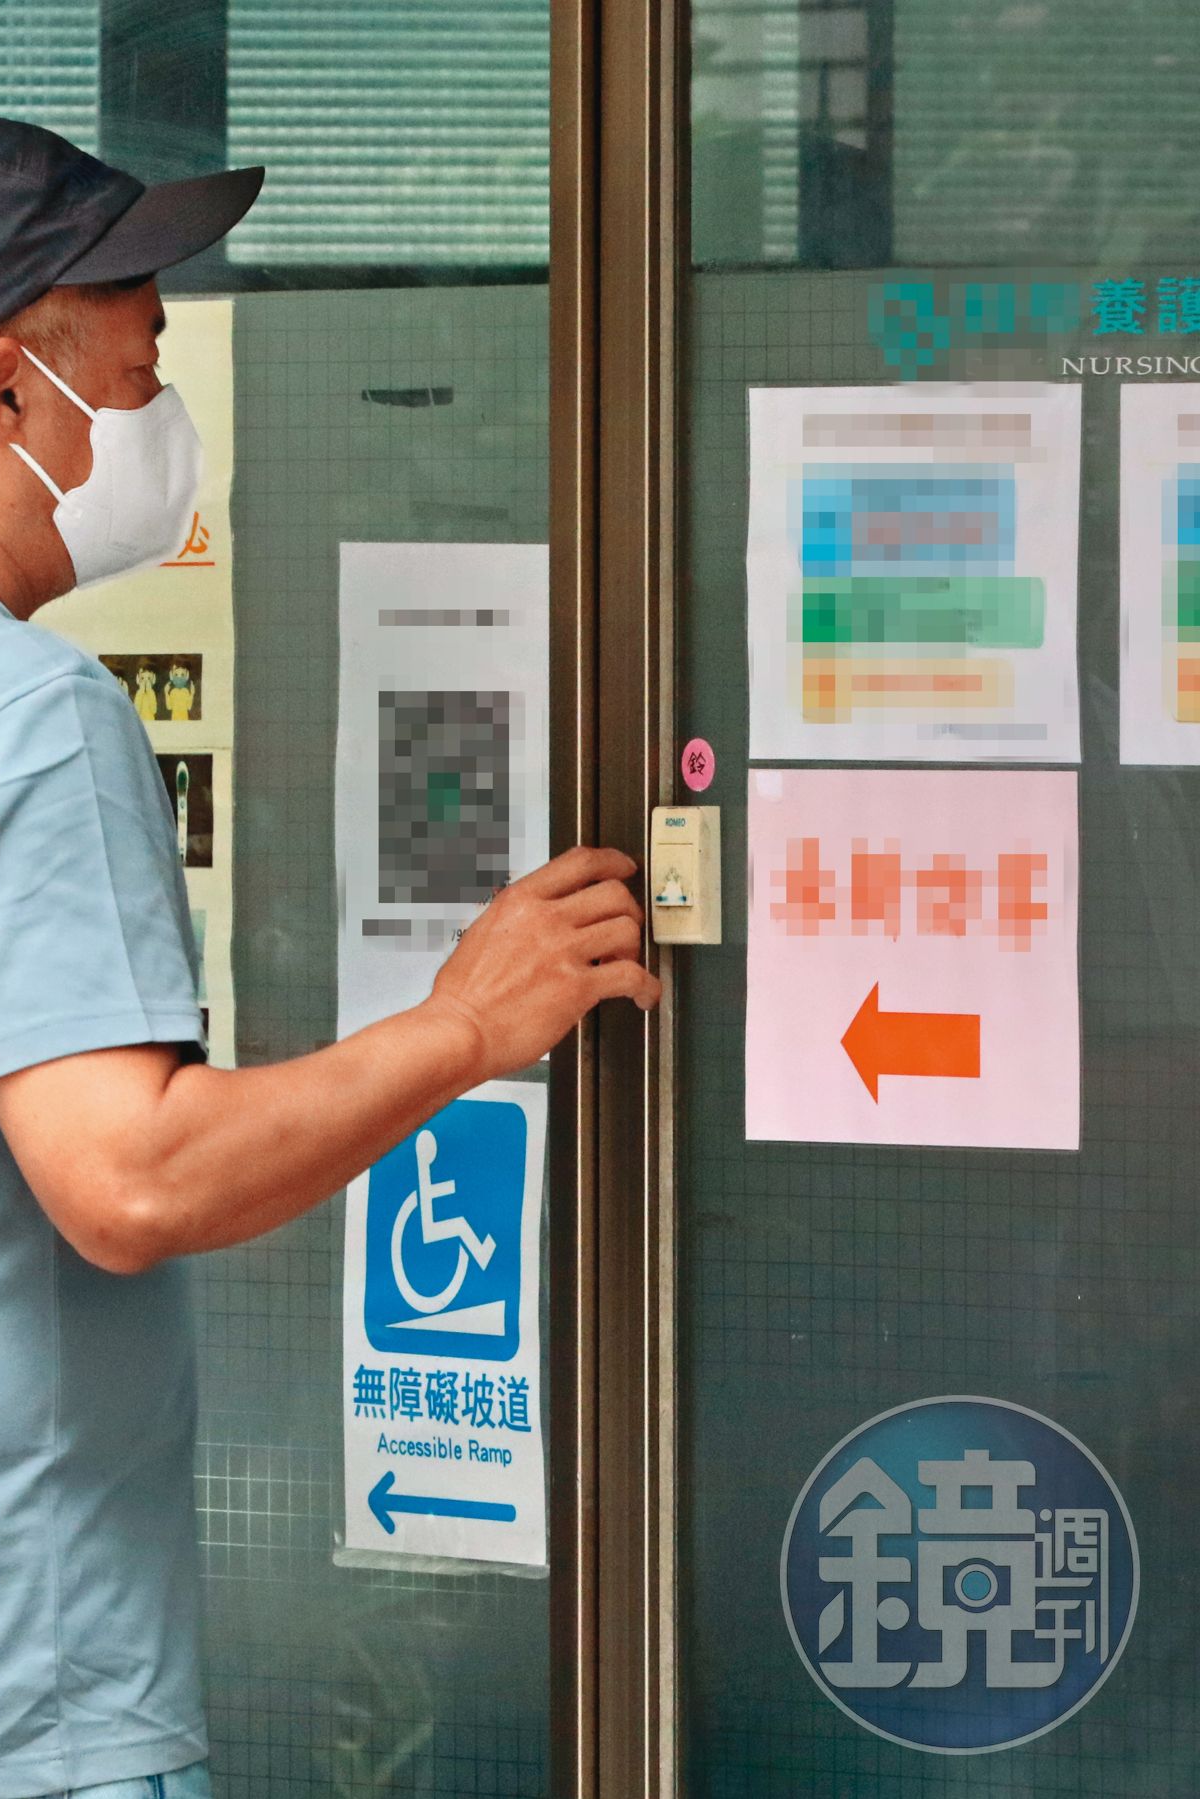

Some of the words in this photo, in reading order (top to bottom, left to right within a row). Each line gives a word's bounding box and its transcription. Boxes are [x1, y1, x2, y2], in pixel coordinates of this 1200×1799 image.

[353, 1364, 532, 1432] 無障礙坡道
[377, 1432, 462, 1460] Accessible
[468, 1439, 512, 1467] Ramp
